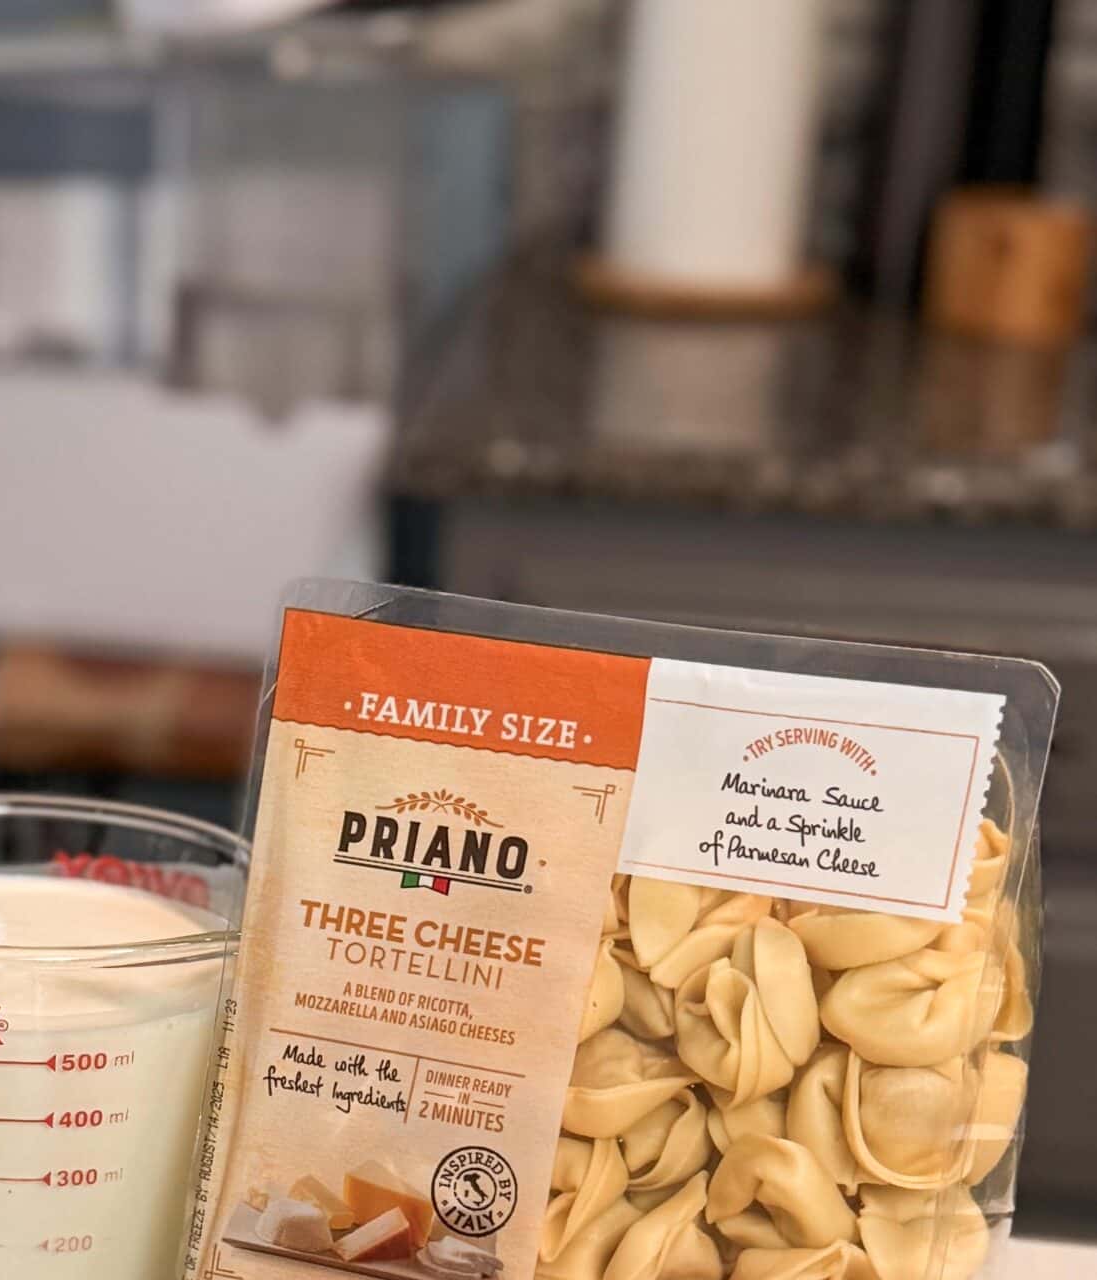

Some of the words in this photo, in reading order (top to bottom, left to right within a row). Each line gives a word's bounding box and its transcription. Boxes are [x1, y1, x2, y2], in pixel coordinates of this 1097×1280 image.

[357, 691, 493, 736] FAMILY
[500, 712, 579, 750] SIZE
[746, 734, 776, 759] TRY
[776, 727, 840, 749] SERVING
[840, 736, 876, 772] WITH
[721, 772, 812, 803] Marinara
[822, 786, 884, 812] Sauce
[337, 809, 529, 880] PRIANO
[725, 804, 763, 829] and
[766, 815, 782, 831] a
[784, 813, 866, 847] Sprinkle
[699, 829, 724, 866] of
[727, 834, 810, 868] Parmesan
[816, 847, 880, 877] Cheese
[300, 897, 409, 945] THREE
[414, 920, 546, 968] CHEESE
[326, 937, 504, 991] TORTELLINI
[294, 992, 378, 1021] MOZZARELLA
[379, 1007, 406, 1026] AND
[409, 1013, 457, 1036] ASIAGO
[459, 1021, 516, 1046] CHEESES
[343, 981, 353, 997] A
[353, 983, 397, 1006] BLEND
[398, 990, 416, 1008] OF
[416, 993, 474, 1020] RICOTTA,
[60, 1053, 108, 1073] 500
[113, 1050, 135, 1068] ml
[263, 1065, 324, 1097] freshest
[282, 1044, 326, 1069] Made
[334, 1053, 369, 1077] with
[375, 1057, 402, 1083] the
[425, 1070, 471, 1091] DINNER
[471, 1076, 513, 1099] READY
[457, 1093, 471, 1106] IN
[58, 1109, 104, 1129] 400
[108, 1107, 130, 1125] ml
[418, 1100, 430, 1118] 2
[431, 1103, 505, 1133] MINUTES
[56, 1168, 99, 1188] 300
[104, 1166, 125, 1183] ml
[438, 1150, 504, 1189] INSPIRED
[498, 1179, 512, 1201] BY
[189, 1205, 205, 1250] FREEZE
[445, 1205, 496, 1232] ITALY
[50, 1235, 94, 1253] 200
[184, 1256, 198, 1271] OR
